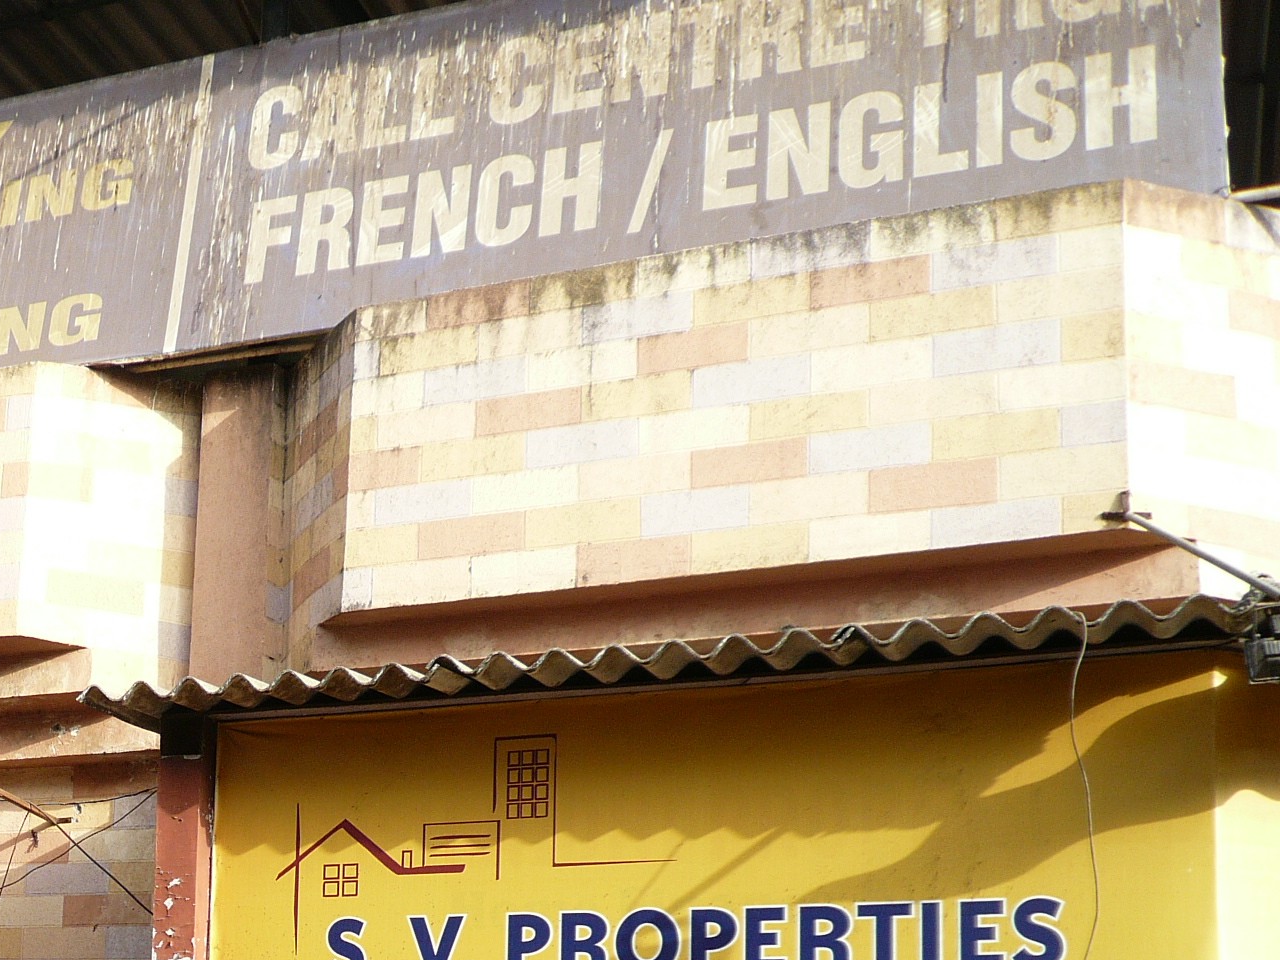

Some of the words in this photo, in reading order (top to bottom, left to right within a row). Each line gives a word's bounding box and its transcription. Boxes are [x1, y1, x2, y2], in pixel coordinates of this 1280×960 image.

[245, 141, 604, 285] FRENCH
[702, 44, 1158, 213] ENGLISH
[247, 61, 456, 171] CALL
[488, 0, 867, 126] CENTRE
